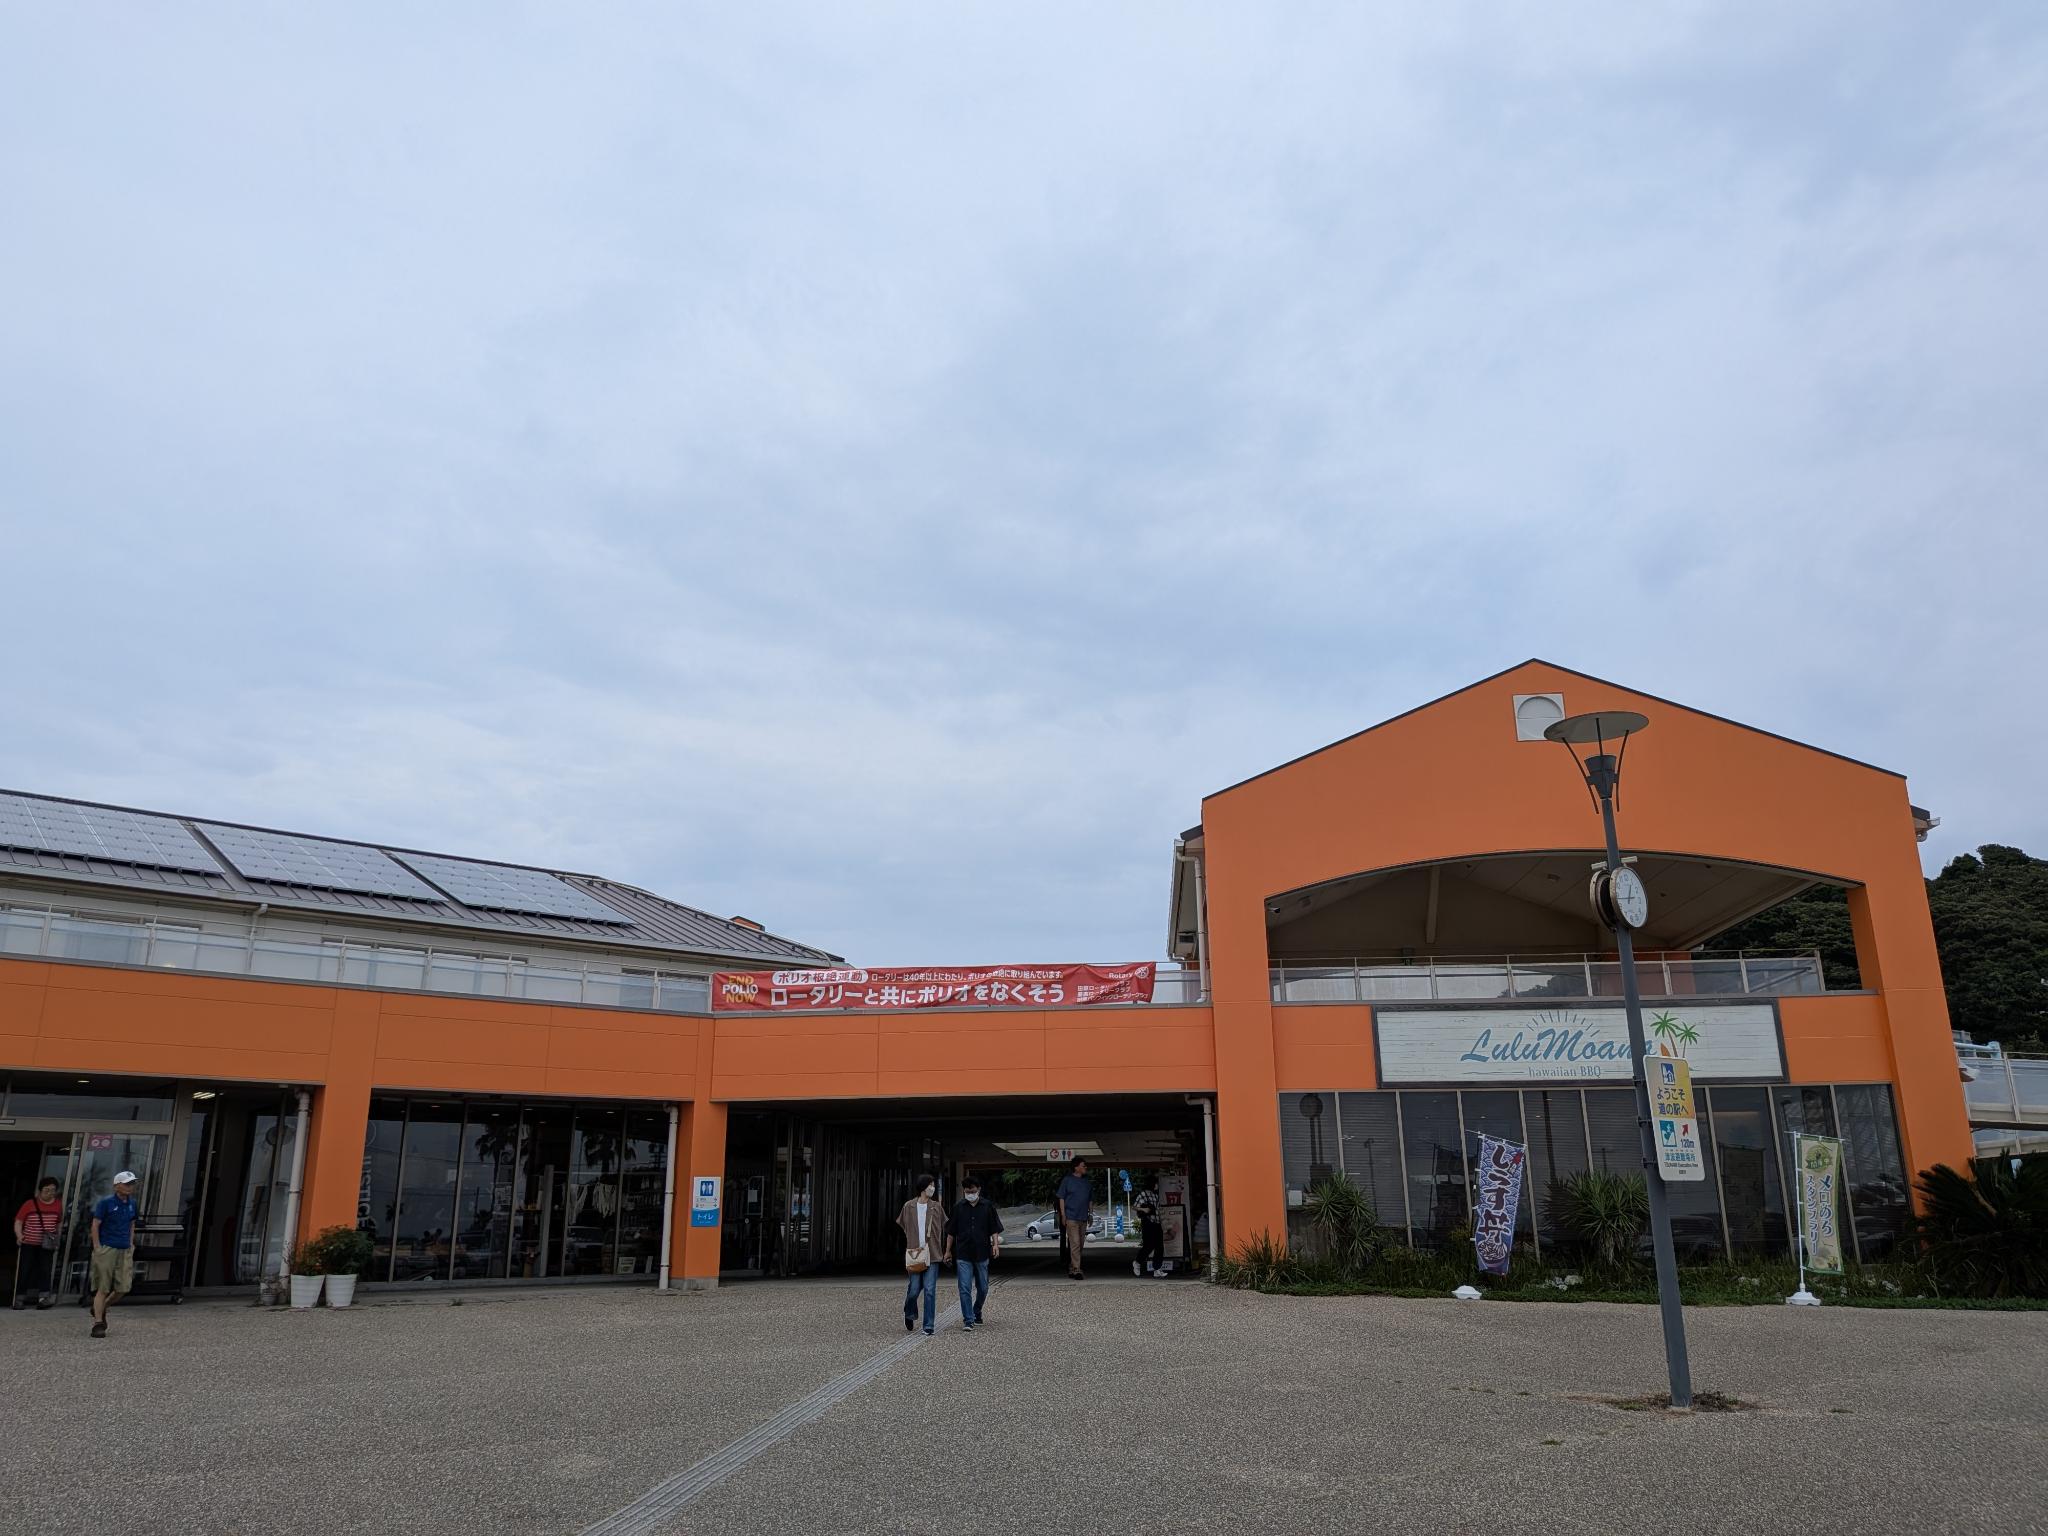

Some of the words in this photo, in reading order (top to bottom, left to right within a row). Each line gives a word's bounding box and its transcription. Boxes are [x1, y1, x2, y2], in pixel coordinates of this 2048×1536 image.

[728, 975, 754, 985] END
[777, 971, 863, 984] ポリオ根絶運動
[722, 984, 758, 994] POLIO
[770, 982, 1064, 1006] ロータリーと共にポリオをなくそう
[726, 993, 755, 1003] NOW
[1528, 1066, 1577, 1078] hawaiian
[1580, 1066, 1601, 1078] BBQ
[1656, 1087, 1686, 1102] ようこそ
[1657, 1102, 1689, 1116] 道の駅へ
[1680, 1138, 1695, 1148] 120m
[1478, 1144, 1511, 1244] しらす丼
[1819, 1174, 1833, 1237] メロめろ
[697, 1213, 714, 1221] トイレ
